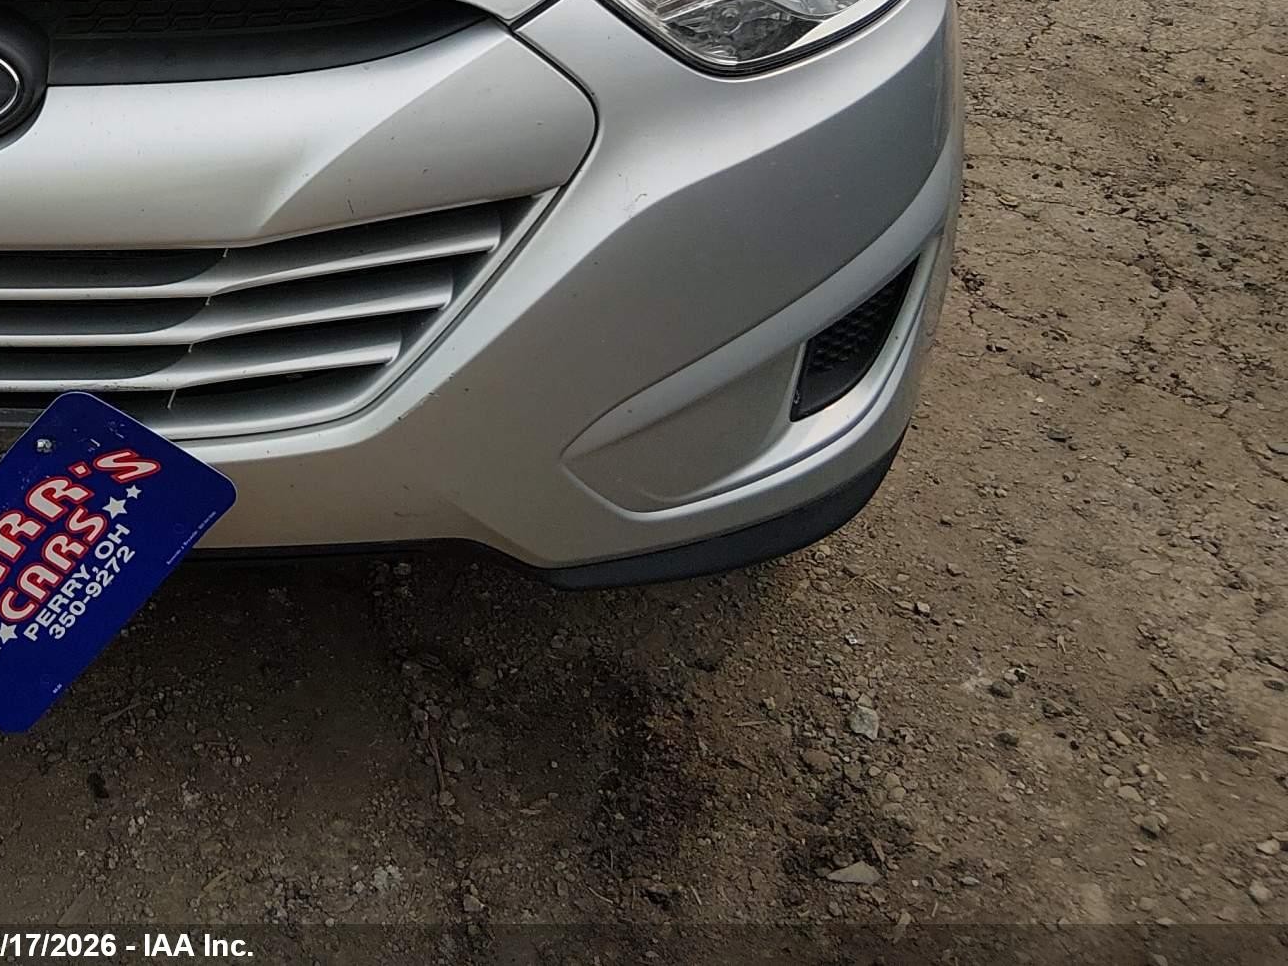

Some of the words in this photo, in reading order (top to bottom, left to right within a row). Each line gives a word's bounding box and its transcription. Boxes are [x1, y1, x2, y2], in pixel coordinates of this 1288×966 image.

[23, 564, 100, 641] PERRY,
[94, 523, 130, 560] OH
[48, 545, 136, 640] 350-9272
